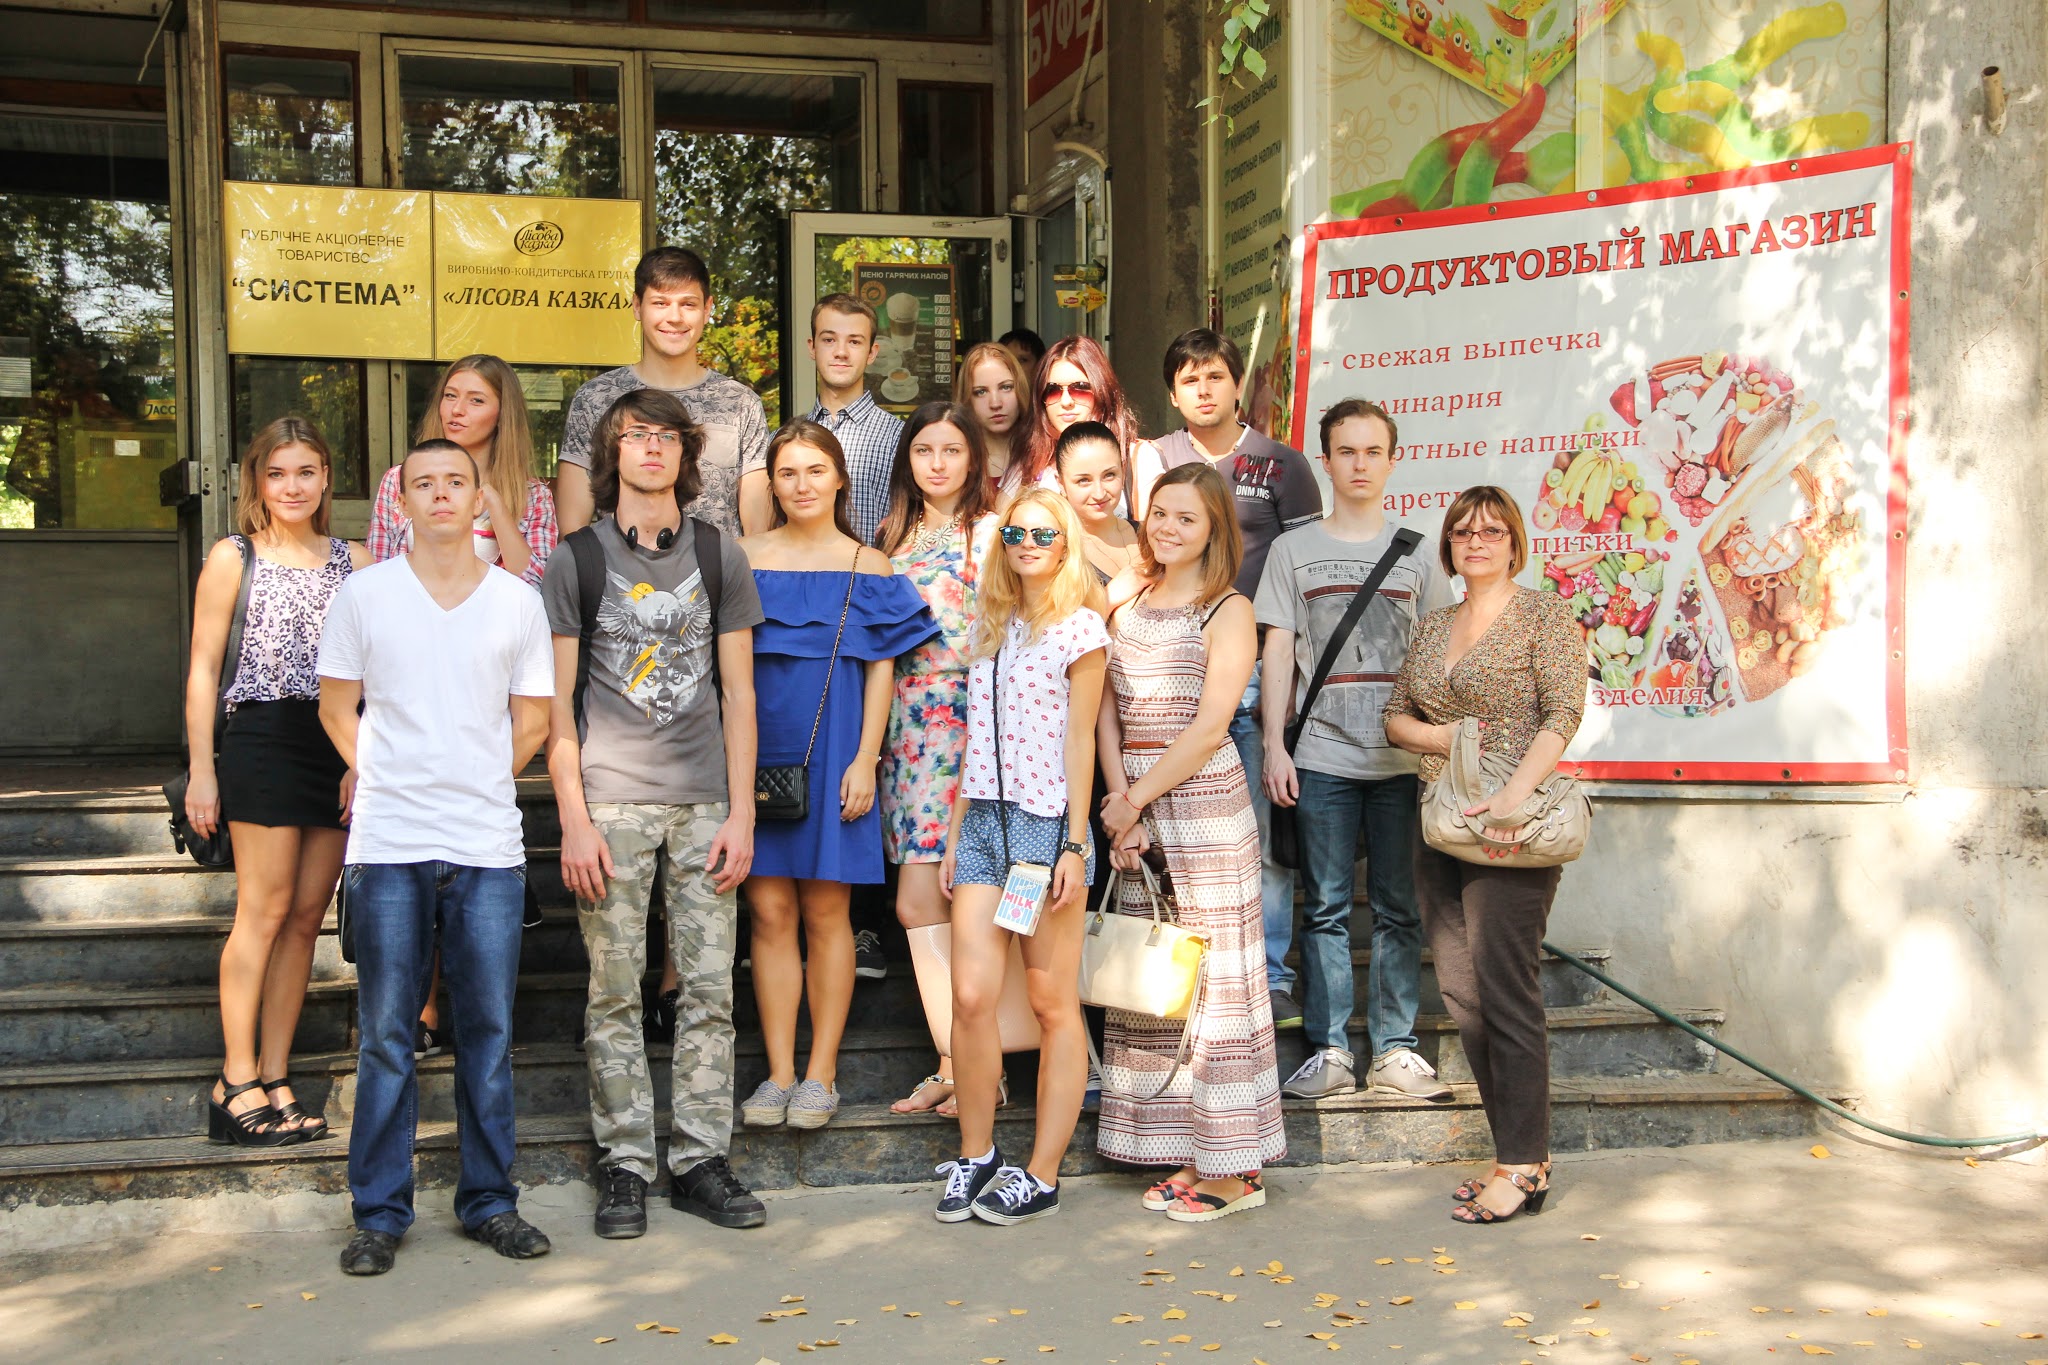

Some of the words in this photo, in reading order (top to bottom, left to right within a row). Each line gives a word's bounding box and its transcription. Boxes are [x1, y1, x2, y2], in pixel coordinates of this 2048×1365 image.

[1029, 0, 1100, 79] БУФЕ
[241, 229, 311, 243] ПУБЛІЧНЕ
[315, 232, 404, 247] АКЦІОНЕРНЕ
[519, 229, 559, 241] Лісова
[518, 239, 556, 252] казка
[1326, 226, 1645, 299] ПРОДУКТОВЫЙ
[1659, 202, 1876, 266] МАГАЗИН
[277, 248, 371, 264] ТОВАРИСТВО
[597, 270, 630, 280] ГРУПА
[861, 271, 884, 279] МЕНЮ
[885, 272, 919, 280] ГАРЯЧИХ
[1342, 346, 1450, 370] свежая
[1463, 331, 1601, 361] выпечка
[145, 403, 176, 418] JACO
[1366, 391, 1503, 417] линария
[1395, 440, 1487, 462] ртные
[1501, 430, 1640, 455] напитки
[1383, 491, 1461, 517] арет
[1532, 534, 1632, 554] питки
[1585, 682, 1704, 708] зделия
[1004, 892, 1035, 910] MILK
